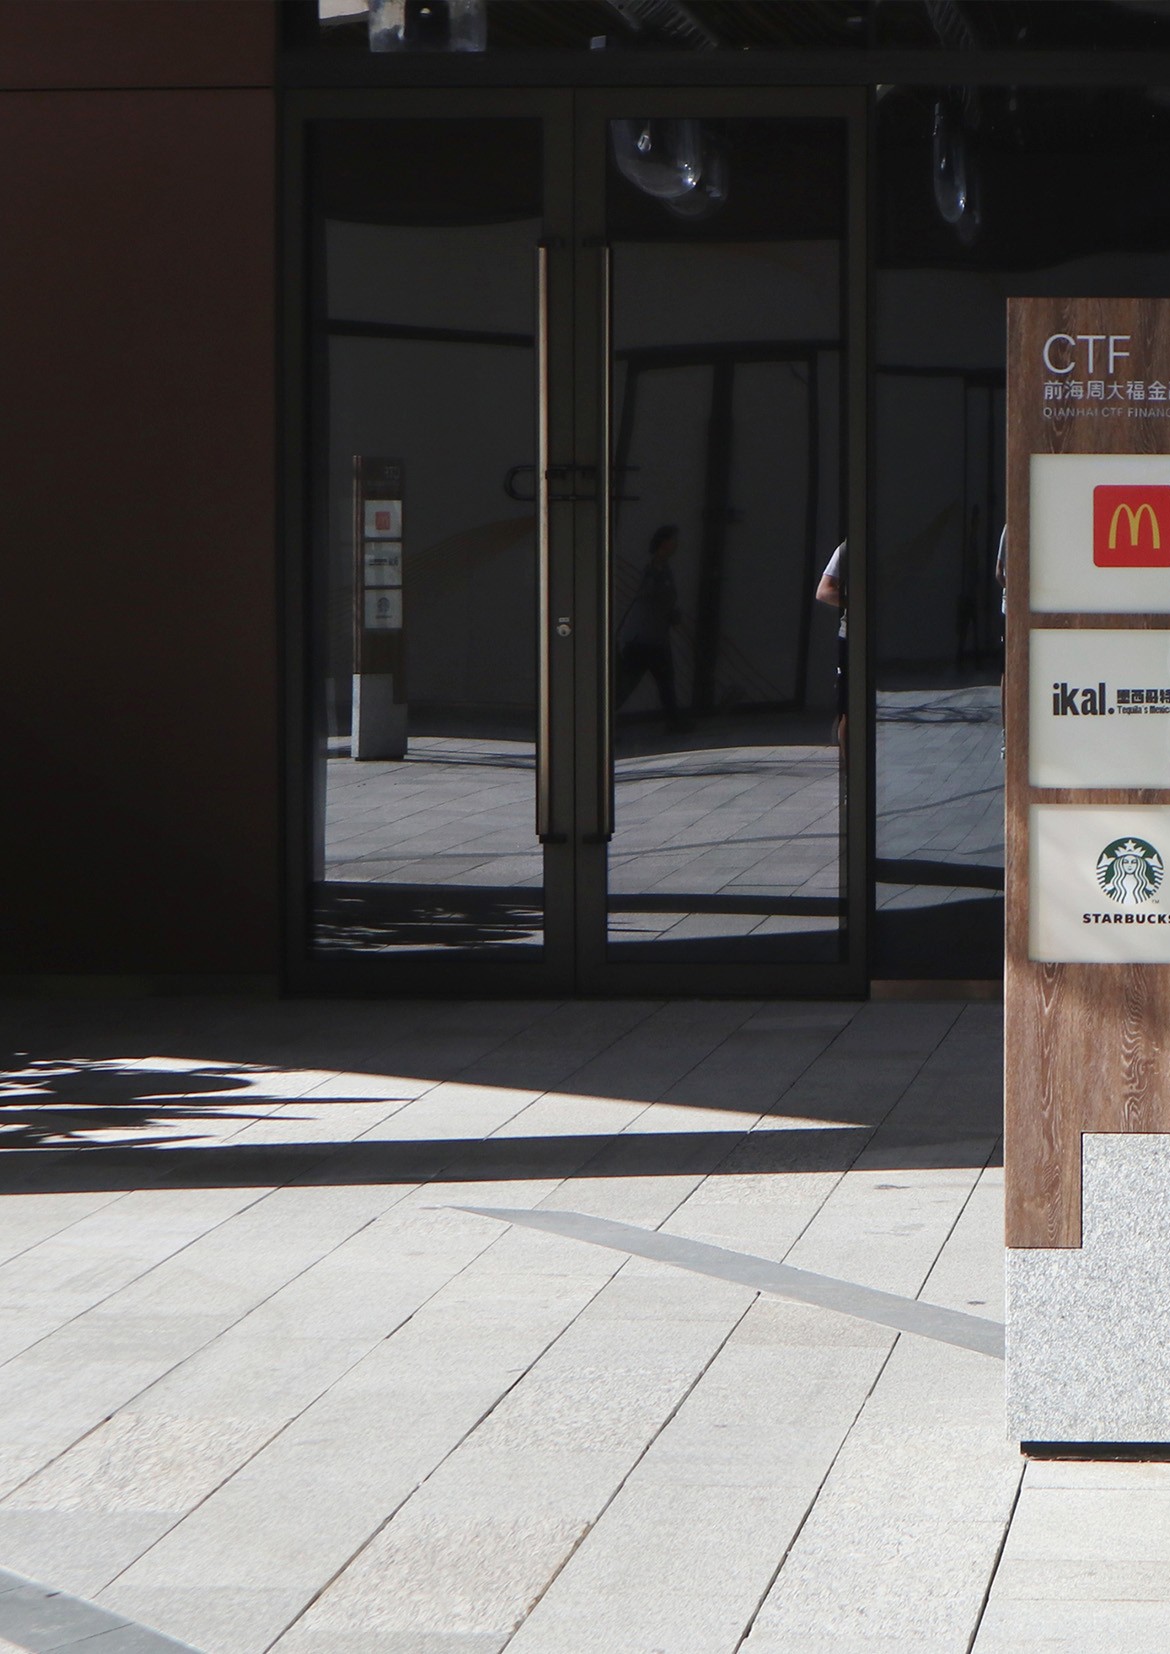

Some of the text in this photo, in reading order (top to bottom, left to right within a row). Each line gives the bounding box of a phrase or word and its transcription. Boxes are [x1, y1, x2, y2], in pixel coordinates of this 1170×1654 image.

[1042, 334, 1131, 374] CTF
[1042, 407, 1098, 418] QIANHAI
[1101, 407, 1124, 418] CTF
